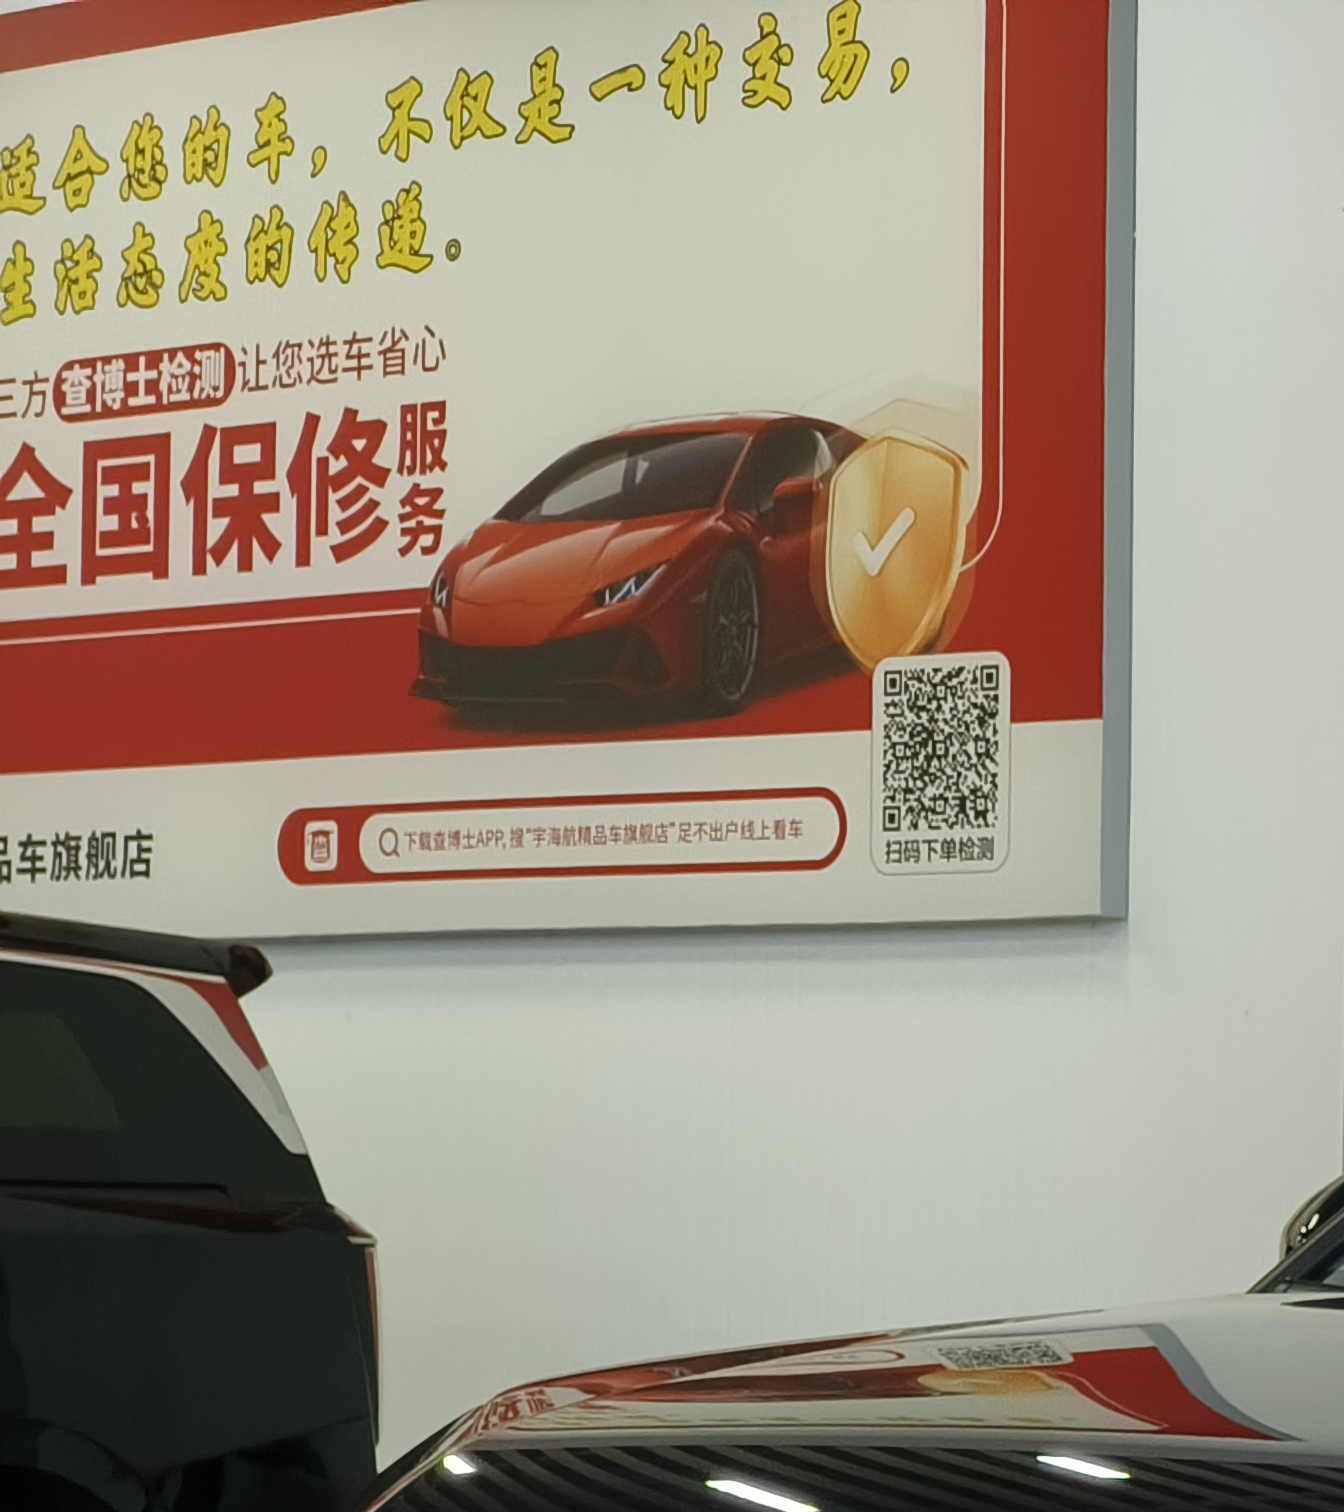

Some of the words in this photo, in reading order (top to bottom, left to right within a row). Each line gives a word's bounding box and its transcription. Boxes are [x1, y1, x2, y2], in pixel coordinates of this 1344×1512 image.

[60, 346, 226, 416] 查博士检测
[237, 324, 447, 394] 让您选车省心
[0, 406, 392, 590] 全国保修
[397, 400, 448, 558] 服务
[884, 836, 995, 865] 扫码下单检测
